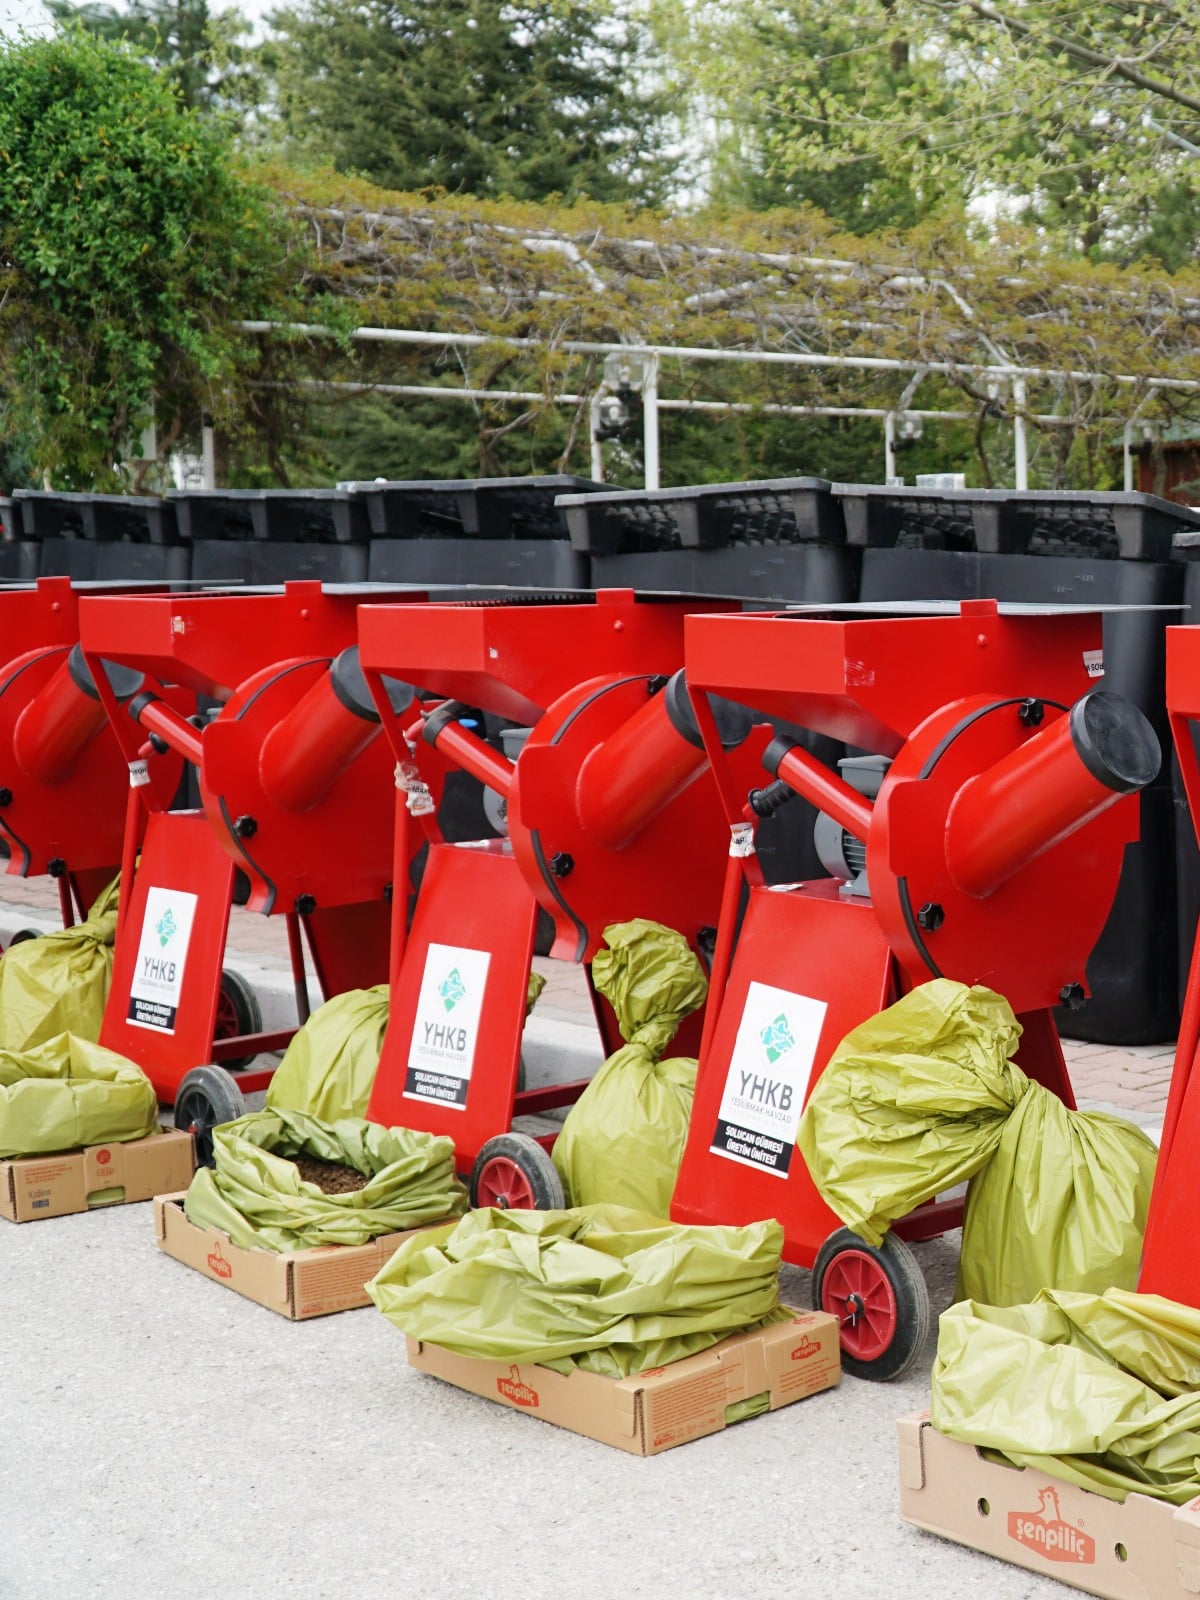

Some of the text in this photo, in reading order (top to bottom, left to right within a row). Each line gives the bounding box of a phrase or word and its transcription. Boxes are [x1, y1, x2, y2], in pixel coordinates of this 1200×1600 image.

[144, 956, 176, 983] YHKB
[424, 1021, 467, 1052] YHKB
[740, 1069, 793, 1111] YHKB
[725, 1125, 784, 1154] SOLUCAN GÜBRESİ
[726, 1138, 777, 1166] ÜRETİM ÜNİTESİ
[1016, 1518, 1085, 1561] şenpiliç
